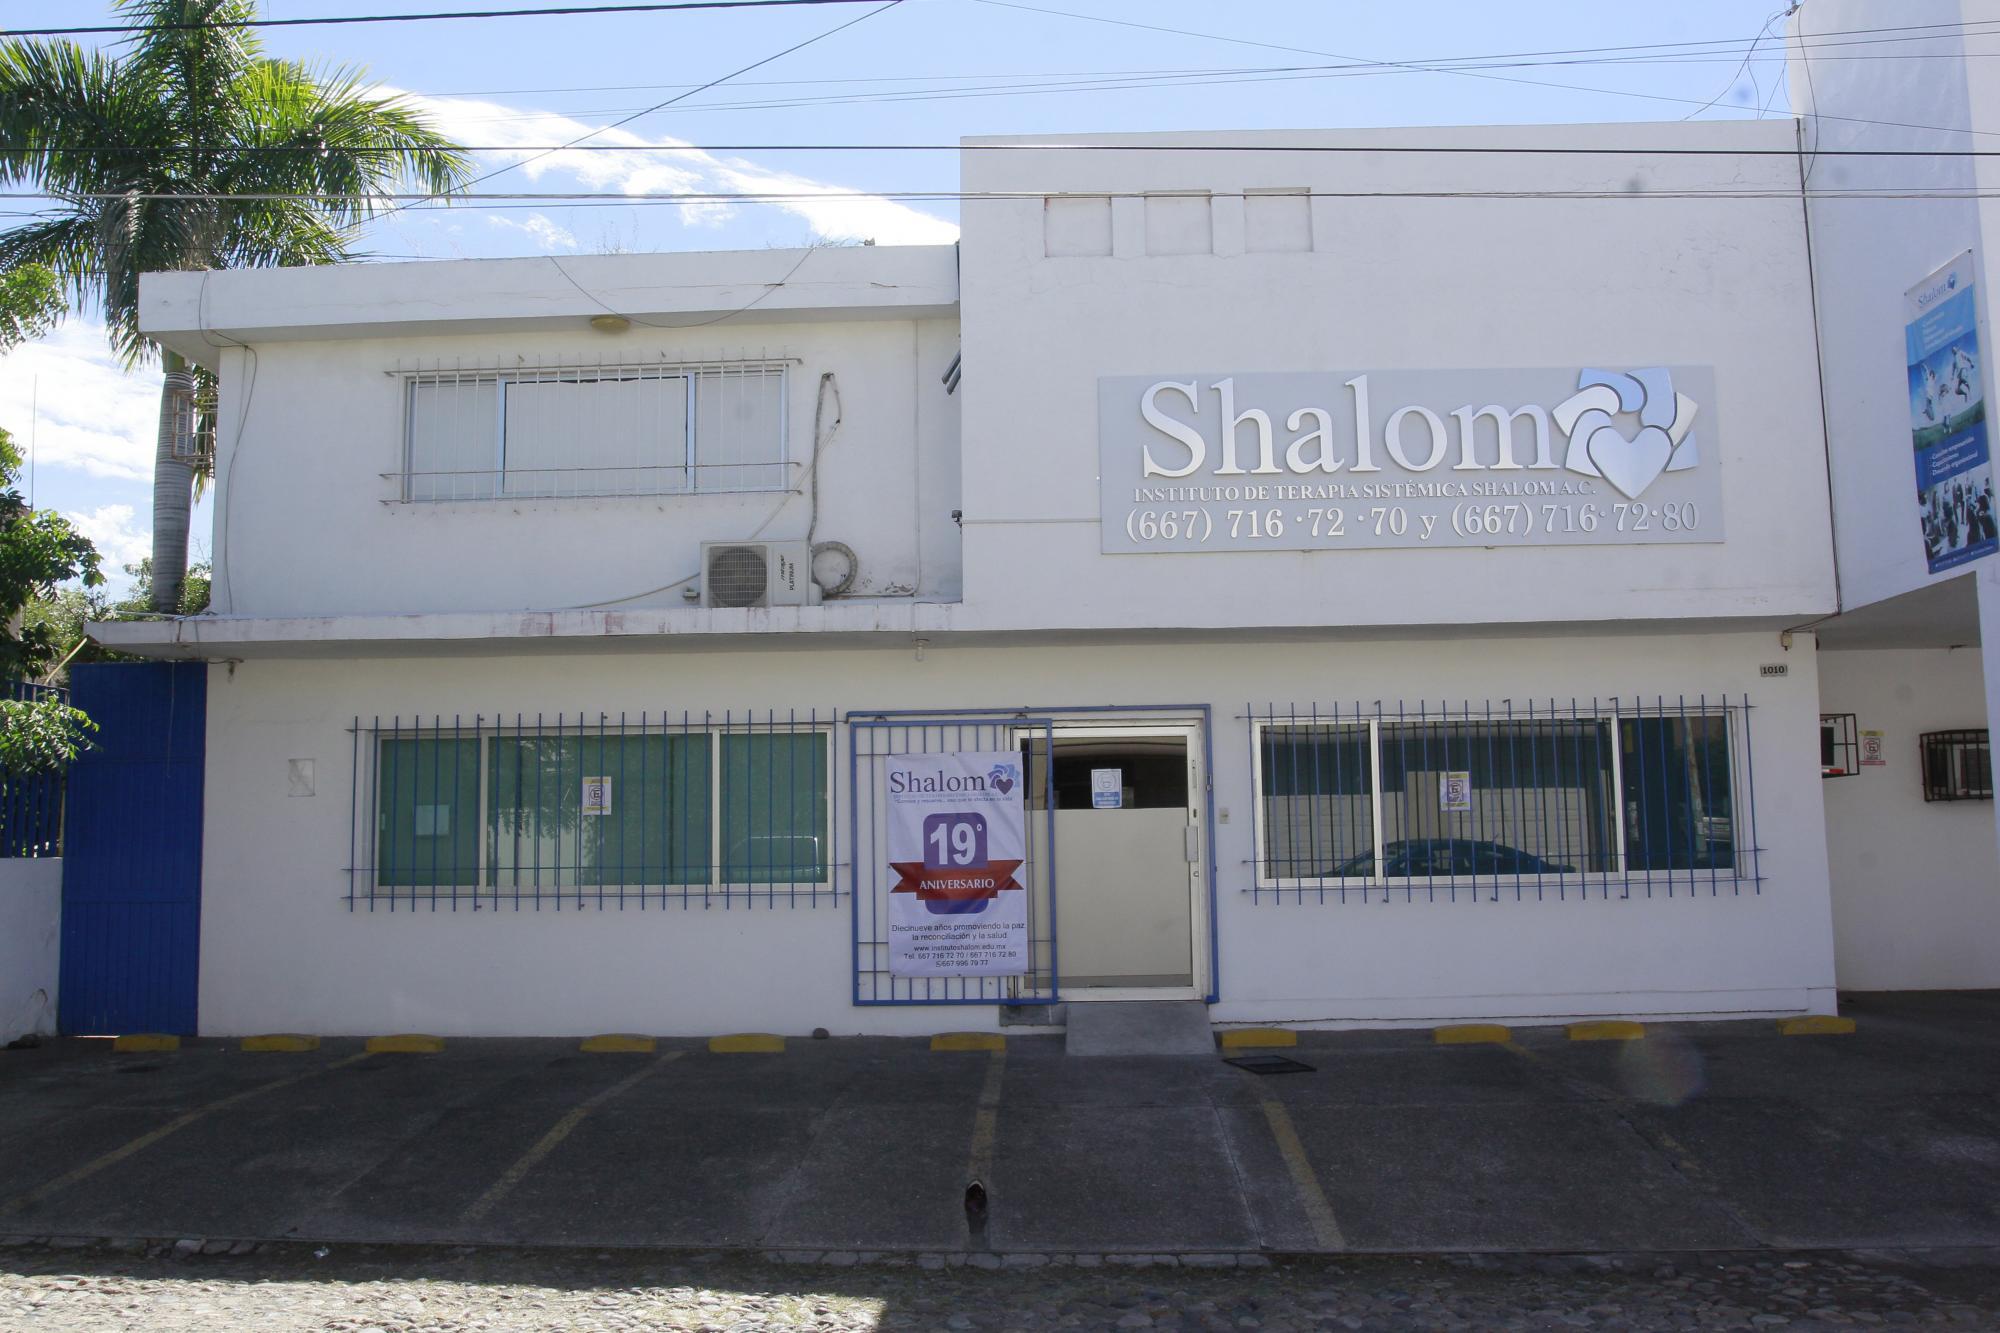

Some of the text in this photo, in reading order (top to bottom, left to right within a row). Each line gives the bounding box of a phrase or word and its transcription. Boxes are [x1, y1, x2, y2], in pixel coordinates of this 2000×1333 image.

[1140, 374, 1560, 478] Shalom
[1134, 479, 1596, 502] INSTITUTO DE TERAPIA SISTÉMICA SHALOM A.C.
[1126, 506, 1212, 542] (667)
[1420, 514, 1438, 540] y
[1452, 502, 1533, 537] (667)
[1763, 665, 1785, 675] 1010
[890, 770, 986, 794] Shalom
[919, 878, 995, 890] ANIVERSARIO
[891, 924, 932, 932] Diecinueve
[934, 923, 952, 931] años
[953, 922, 1001, 932] promoviendo
[921, 932, 970, 941] reconciliación
[987, 931, 1007, 939] salud
